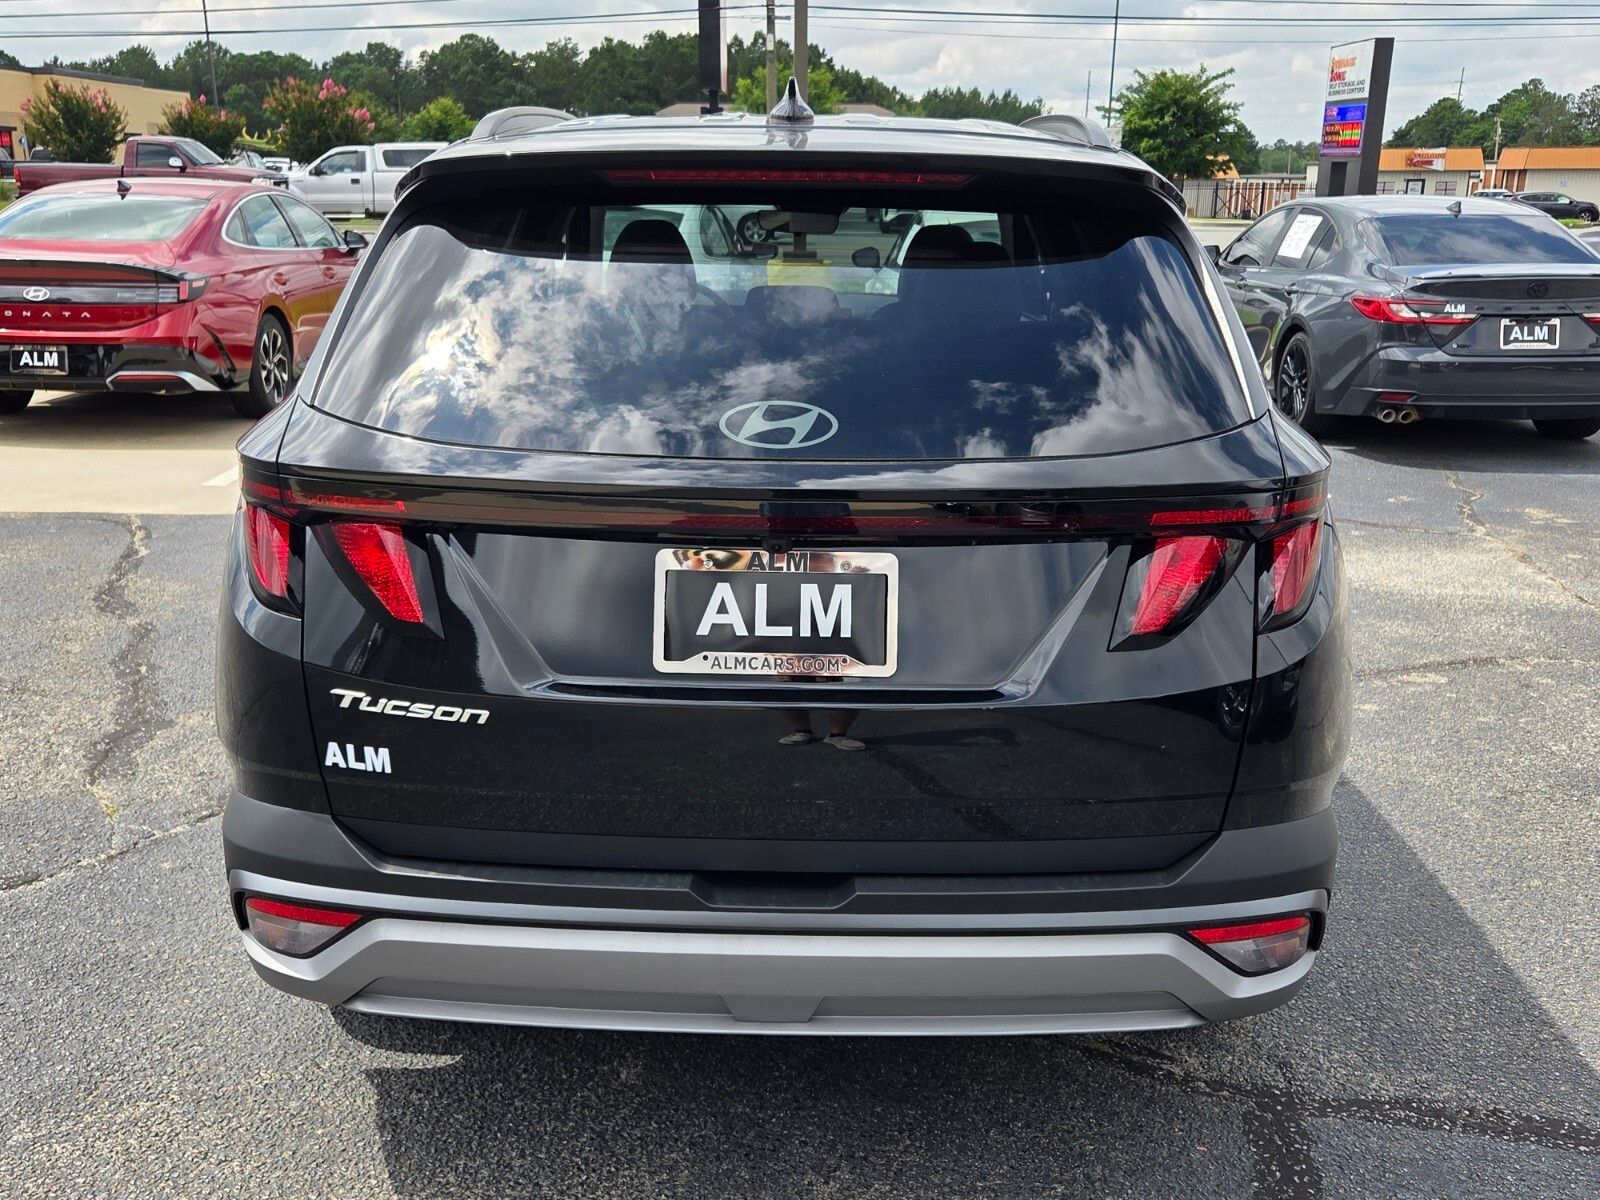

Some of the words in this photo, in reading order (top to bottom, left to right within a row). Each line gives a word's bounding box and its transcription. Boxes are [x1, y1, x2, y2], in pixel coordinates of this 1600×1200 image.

[1444, 303, 1465, 312] ALM
[1509, 325, 1549, 341] ALM
[20, 351, 58, 367] ALM
[748, 552, 809, 572] ALM
[695, 582, 852, 638] ALM
[710, 656, 841, 672] ALMCARS.COM
[325, 741, 392, 774] ALM
